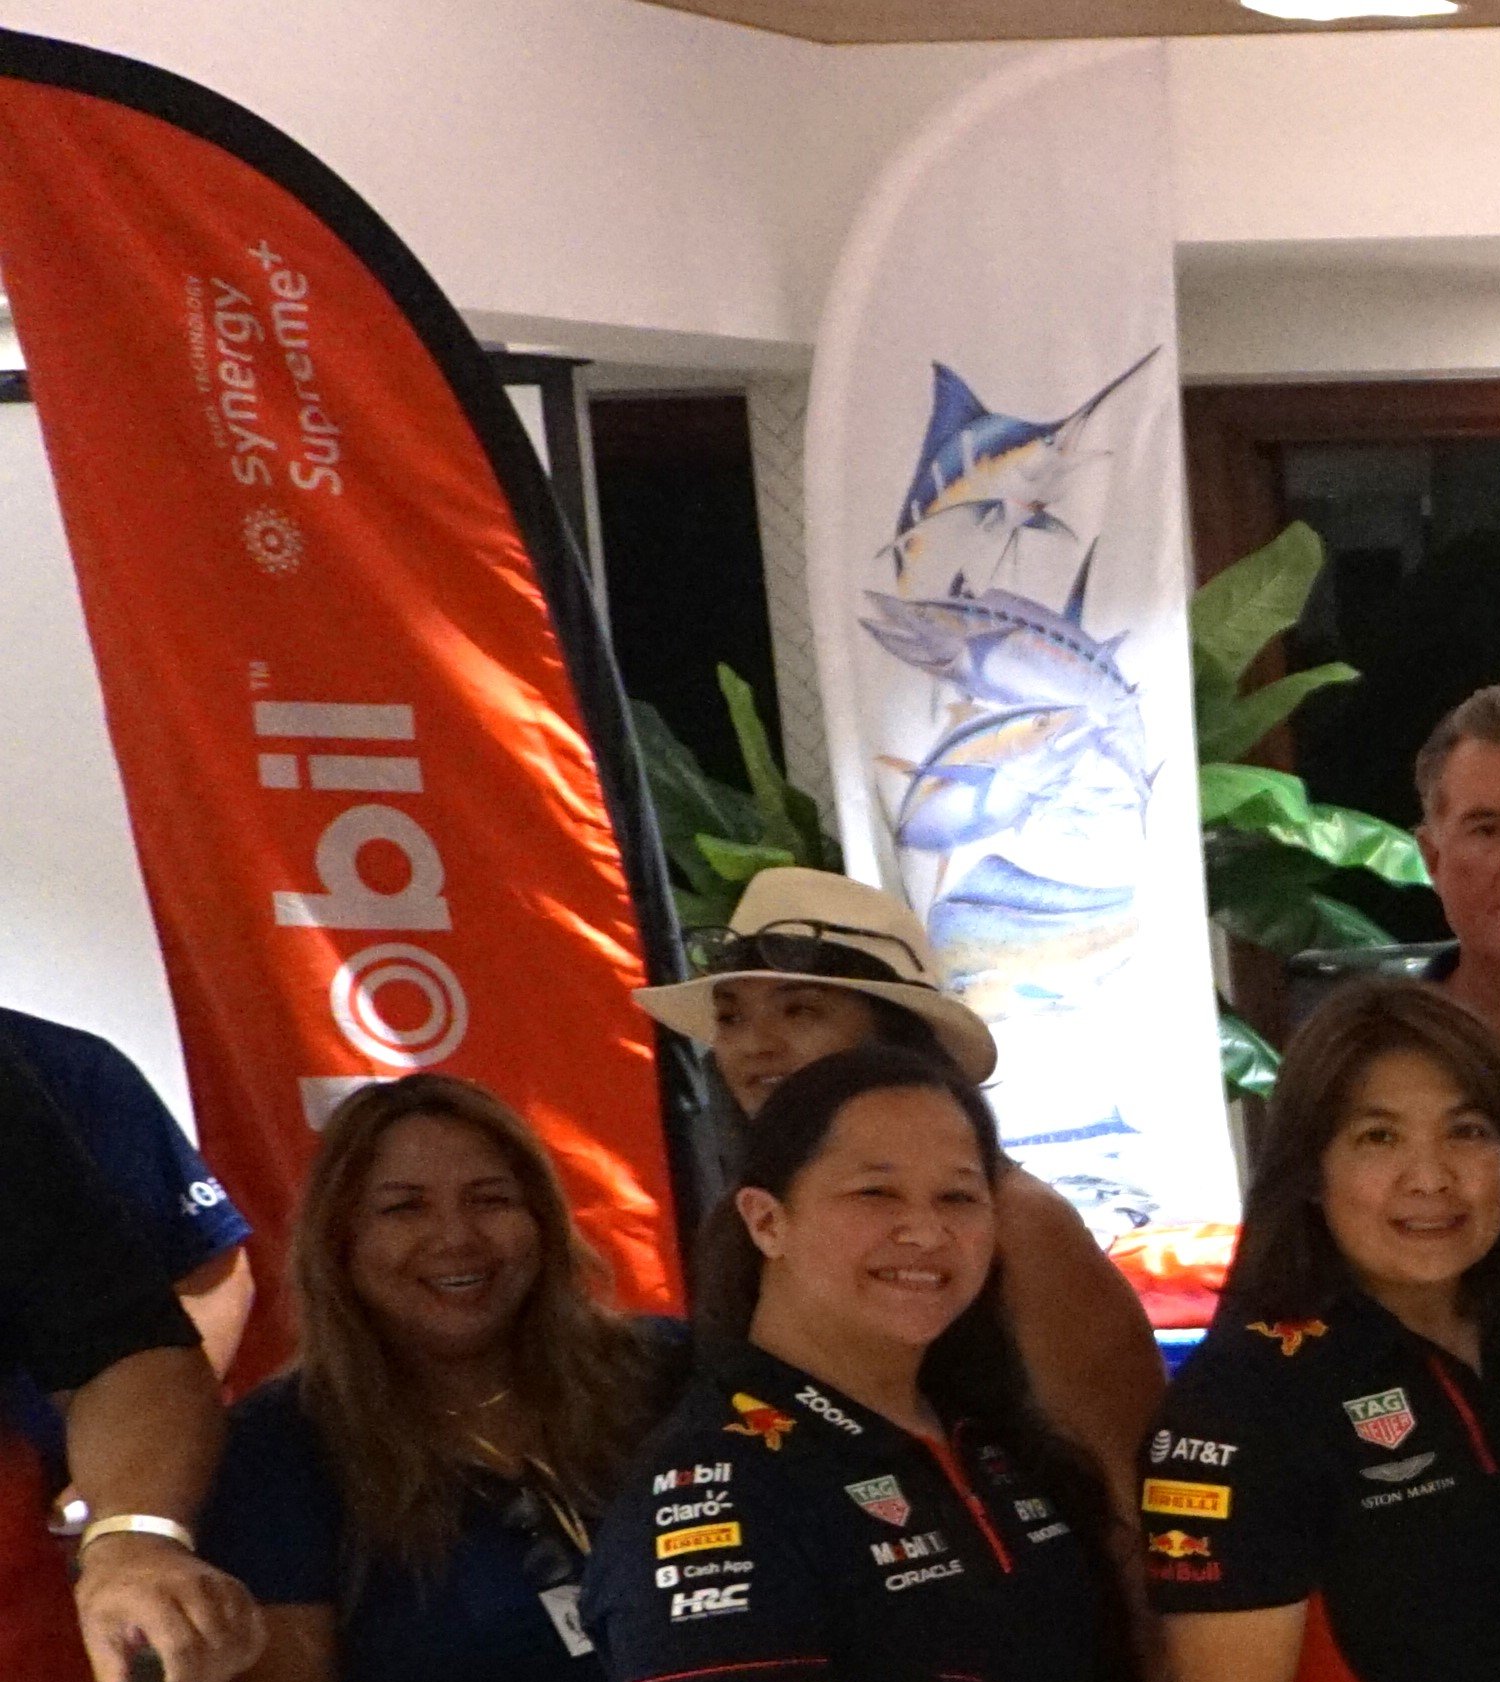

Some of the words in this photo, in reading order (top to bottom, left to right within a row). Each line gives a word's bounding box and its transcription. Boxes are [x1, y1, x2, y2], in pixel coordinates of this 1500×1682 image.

[210, 277, 278, 486] Synergy
[795, 1384, 864, 1436] zoom
[1349, 1393, 1403, 1420] TAG
[1171, 1437, 1240, 1467] AT&T
[653, 1462, 732, 1495] Mobil
[655, 1494, 727, 1527] Claro
[683, 1562, 720, 1579] Cash
[722, 1560, 755, 1574] App
[885, 1559, 965, 1592] ORACLE
[671, 1583, 752, 1618] HRC
